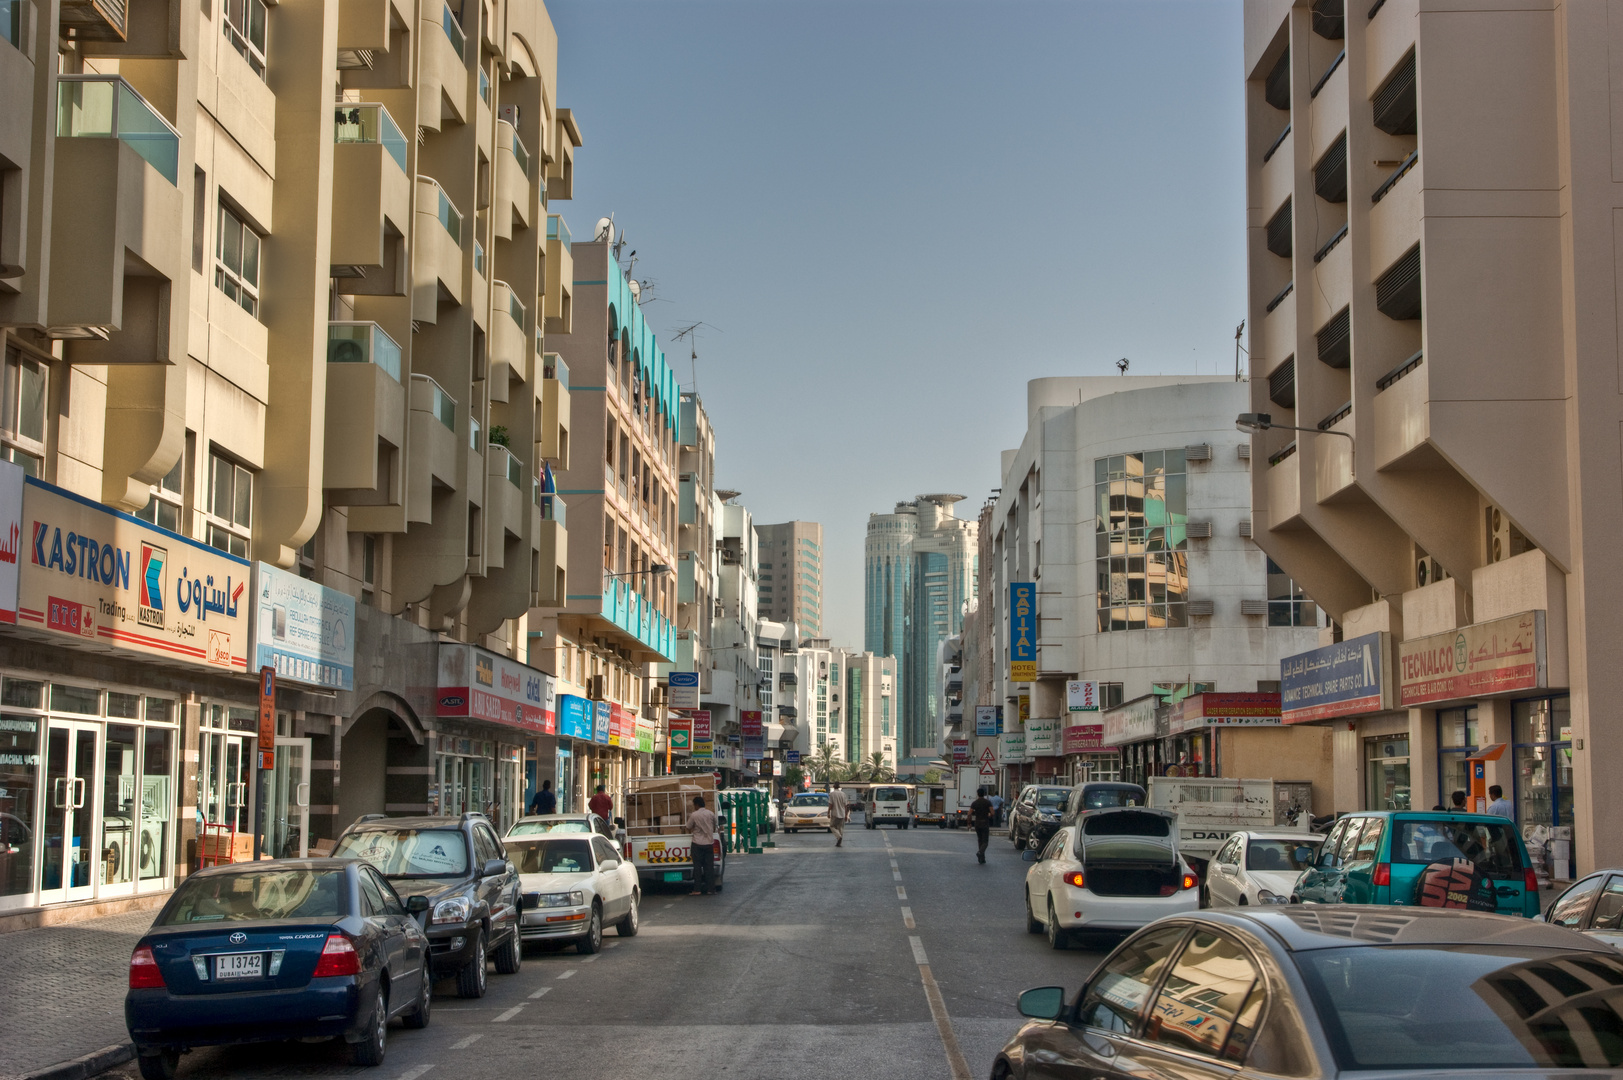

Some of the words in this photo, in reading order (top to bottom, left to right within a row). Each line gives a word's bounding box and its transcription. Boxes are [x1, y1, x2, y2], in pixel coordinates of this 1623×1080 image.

[31, 520, 131, 590] KASTRON
[177, 566, 244, 621] كاسترون
[51, 603, 78, 627] KTC
[99, 598, 126, 622] Trading
[140, 606, 164, 626] KASTRON
[1016, 587, 1031, 657] CAPITAL
[1402, 646, 1453, 680] TECNALCO
[1084, 682, 1093, 706] SUPER
[1284, 687, 1301, 702] ADVANCE
[1302, 682, 1323, 699] TECHNICAL
[1324, 678, 1338, 695] SPARE
[1339, 675, 1353, 692] PARTS
[1402, 686, 1420, 699] TECHNICAL
[1476, 767, 1483, 776] P
[1447, 891, 1468, 903] 2002
[231, 956, 261, 969] 13742
